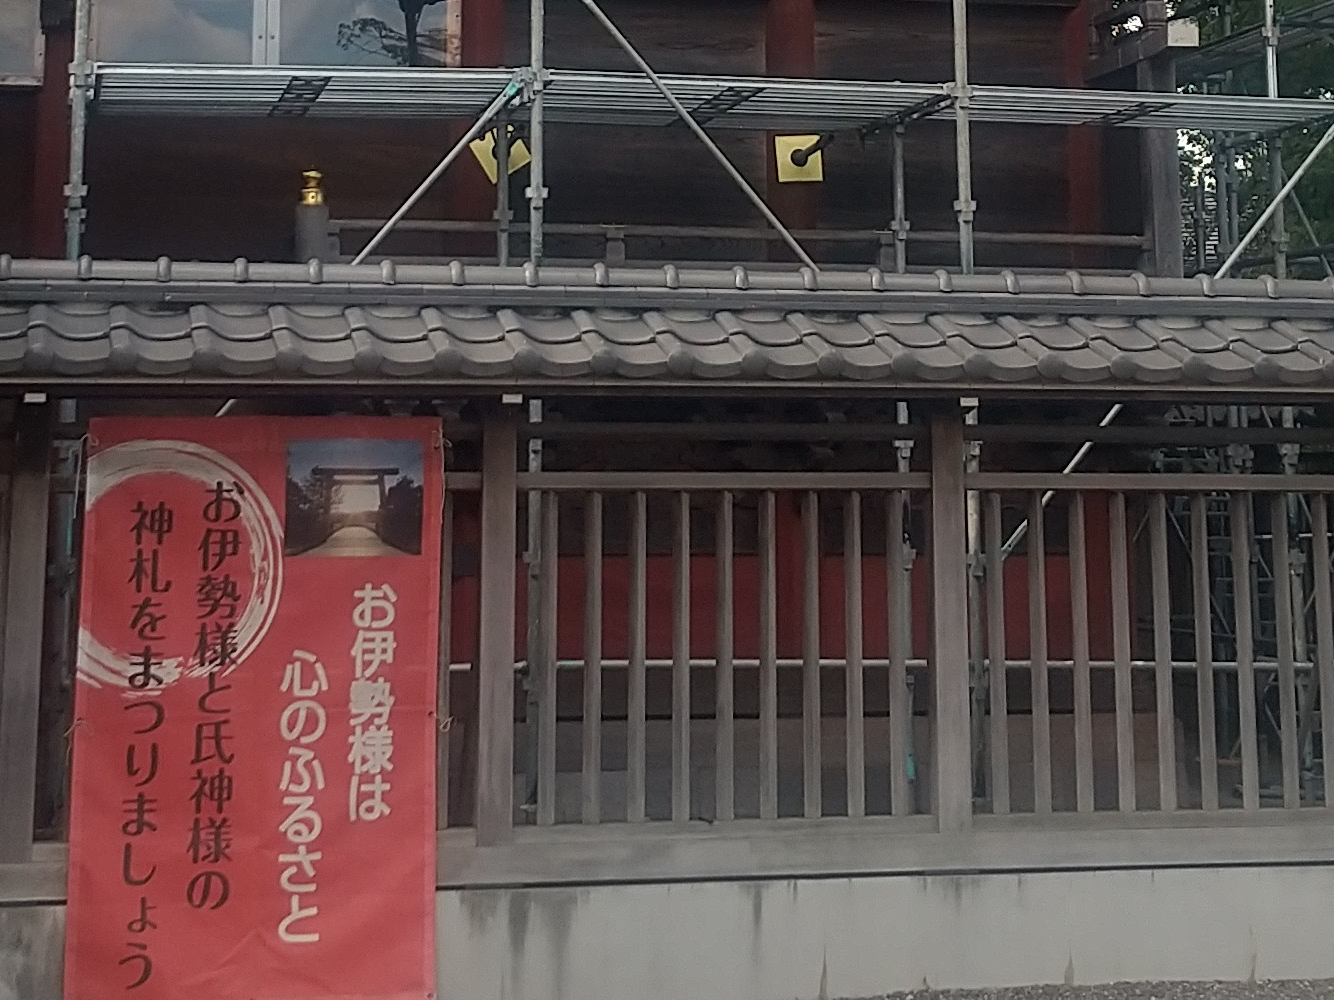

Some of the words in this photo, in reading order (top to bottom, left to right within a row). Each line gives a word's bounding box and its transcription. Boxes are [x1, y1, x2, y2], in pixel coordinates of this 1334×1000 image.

[118, 501, 174, 990] 神札をまつりましょう
[186, 480, 245, 911] お伊勢様と氏神様の
[277, 649, 328, 944] 心のふるさと
[348, 582, 398, 822] お伊勢様は
